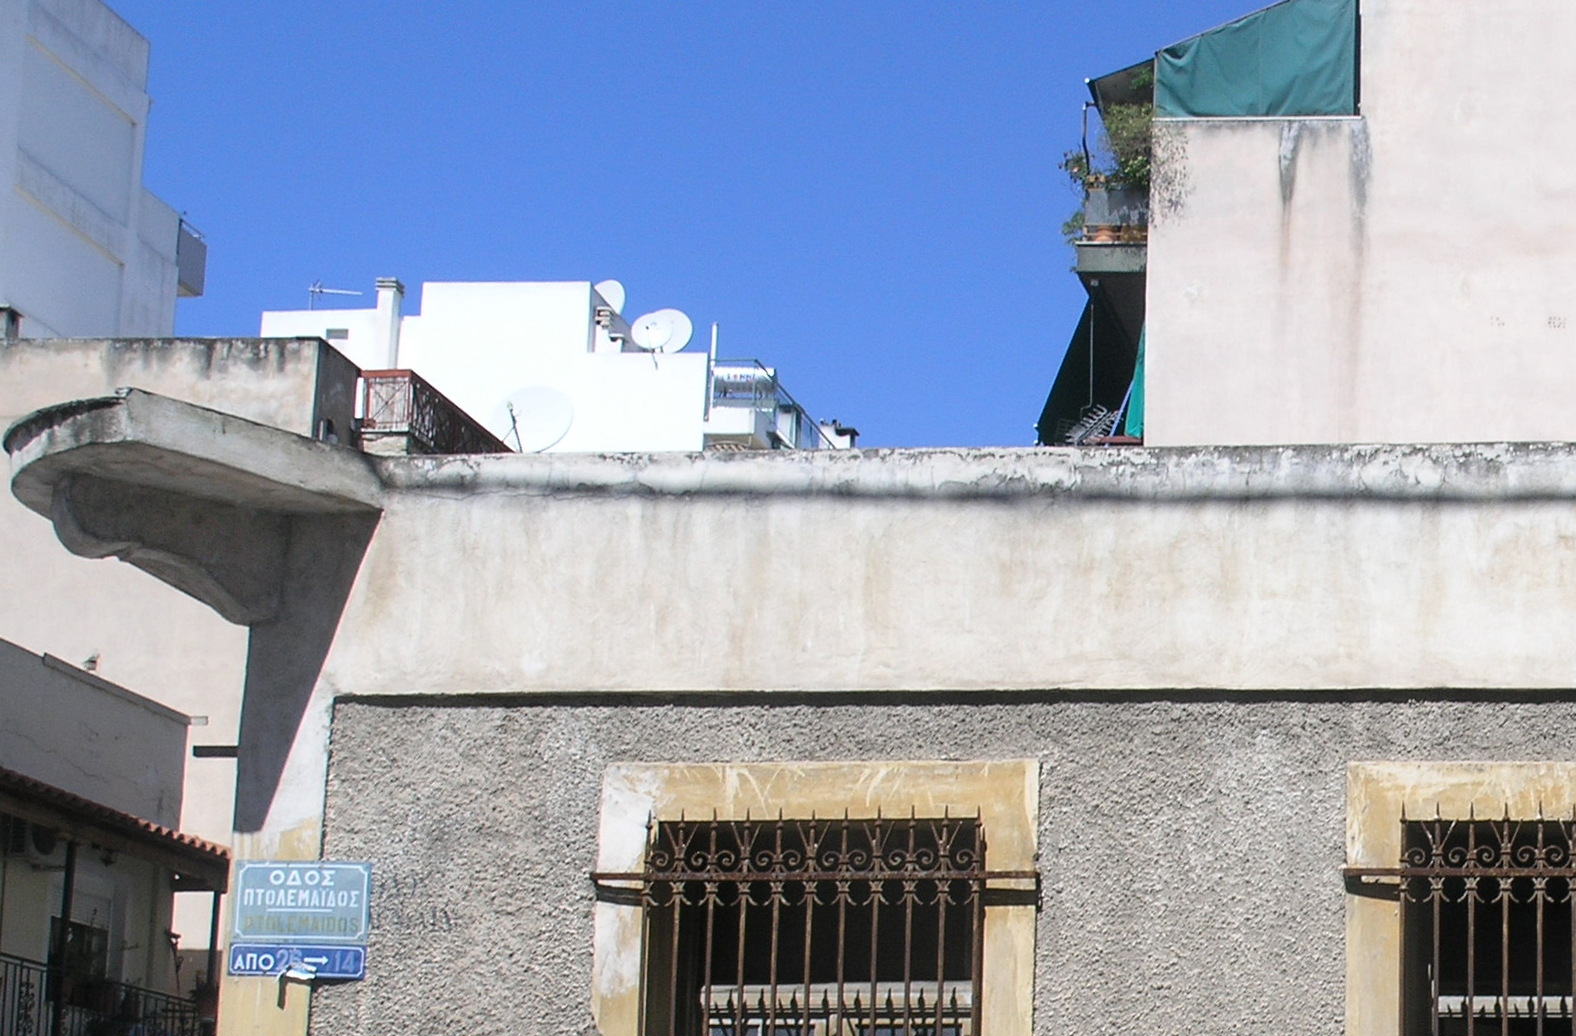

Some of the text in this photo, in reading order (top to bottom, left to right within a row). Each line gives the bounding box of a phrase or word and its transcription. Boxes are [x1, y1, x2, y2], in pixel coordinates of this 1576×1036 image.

[269, 869, 336, 886] ΟΔΟΣ
[243, 887, 360, 908] ΠΤΟΛΕΜΑΪΔΟΣ
[243, 914, 359, 933] PTOLEMAIDOS
[233, 953, 275, 970] ΑΠΟ
[334, 951, 355, 973] 14
